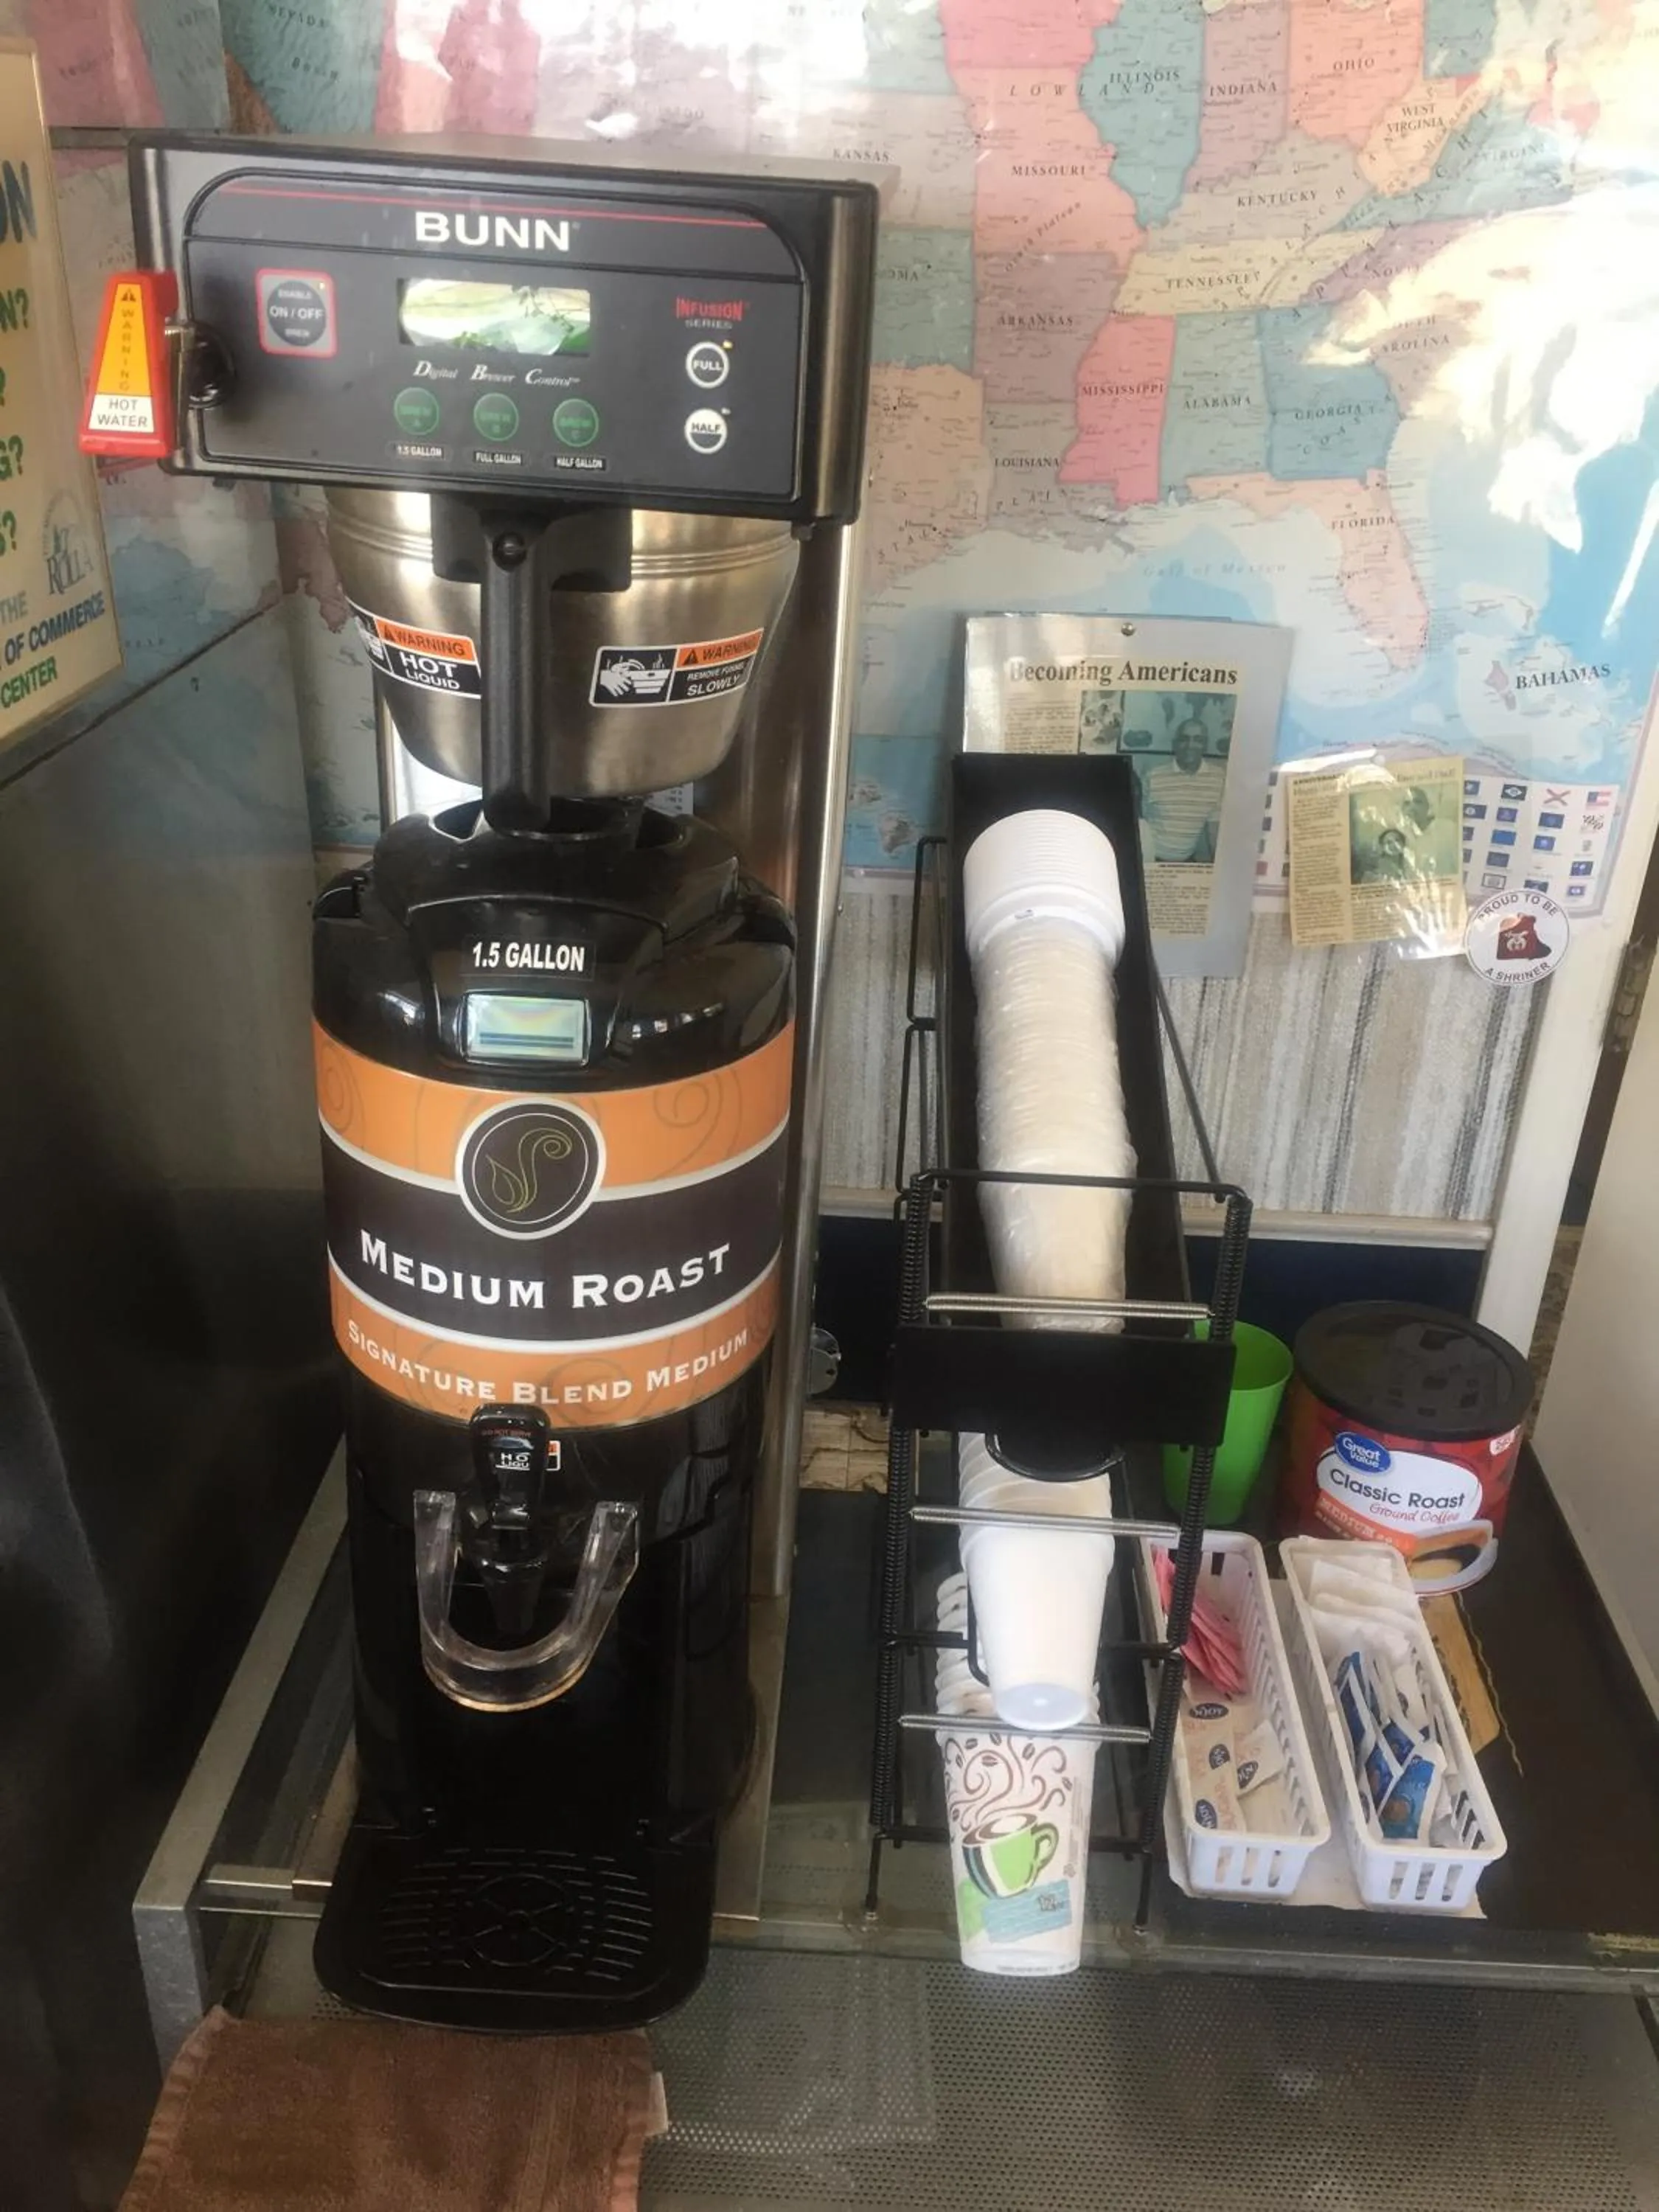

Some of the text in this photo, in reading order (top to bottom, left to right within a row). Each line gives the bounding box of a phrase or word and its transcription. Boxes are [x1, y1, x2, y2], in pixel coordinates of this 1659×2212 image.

[1333, 58, 1374, 72] OHIO
[1110, 70, 1180, 83] ILLINOIS
[1209, 81, 1277, 97] INDIANA
[1402, 104, 1436, 116] WEST
[1387, 117, 1444, 133] VIRGINIA
[833, 148, 889, 162] KANSAS
[1012, 165, 1085, 176] MISSOURI
[0, 159, 37, 243] N
[1237, 190, 1318, 207] KENTUCKY
[415, 212, 570, 251] BUNN
[676, 297, 743, 321] INFUSION
[999, 315, 1073, 326] ARKANSAS
[694, 359, 722, 371] FULL
[1082, 383, 1164, 397] MISSISSIPPI
[108, 400, 139, 411] HOT
[1183, 395, 1251, 410] ALABAMA
[1295, 404, 1362, 420] GEORGIA
[97, 414, 148, 428] WATER
[692, 422, 721, 433] HALF
[411, 446, 442, 457] GALLON
[476, 452, 521, 465] FULL GALLON
[557, 457, 603, 469] HALF GALLON
[995, 458, 1060, 468] LOUISIANA
[1332, 517, 1394, 530] FLORIDA
[0, 591, 28, 624] THE
[4, 591, 105, 665] OF COMMERCE
[394, 630, 465, 657] WARNING
[399, 651, 458, 678] HOT
[1, 655, 58, 709] CENTER
[406, 670, 461, 690] LIQUID
[1009, 661, 1238, 686] Becoming Americans
[1516, 664, 1611, 689] BAHAMAS
[687, 675, 741, 696] SLOWLY
[1525, 894, 1540, 904] TO
[1542, 901, 1558, 916] BE
[473, 942, 585, 972] 1.5 GALLON
[1486, 961, 1551, 981] A SHRINER
[360, 1228, 730, 1310] MEDIUM ROAST
[348, 1319, 748, 1405] SIGNATURE BLEND MEDIUM
[1342, 1437, 1381, 1461] Great
[1349, 1450, 1380, 1467] Value
[1330, 1468, 1466, 1509] Classic Roast
[1368, 1503, 1460, 1524] Ground Coffee
